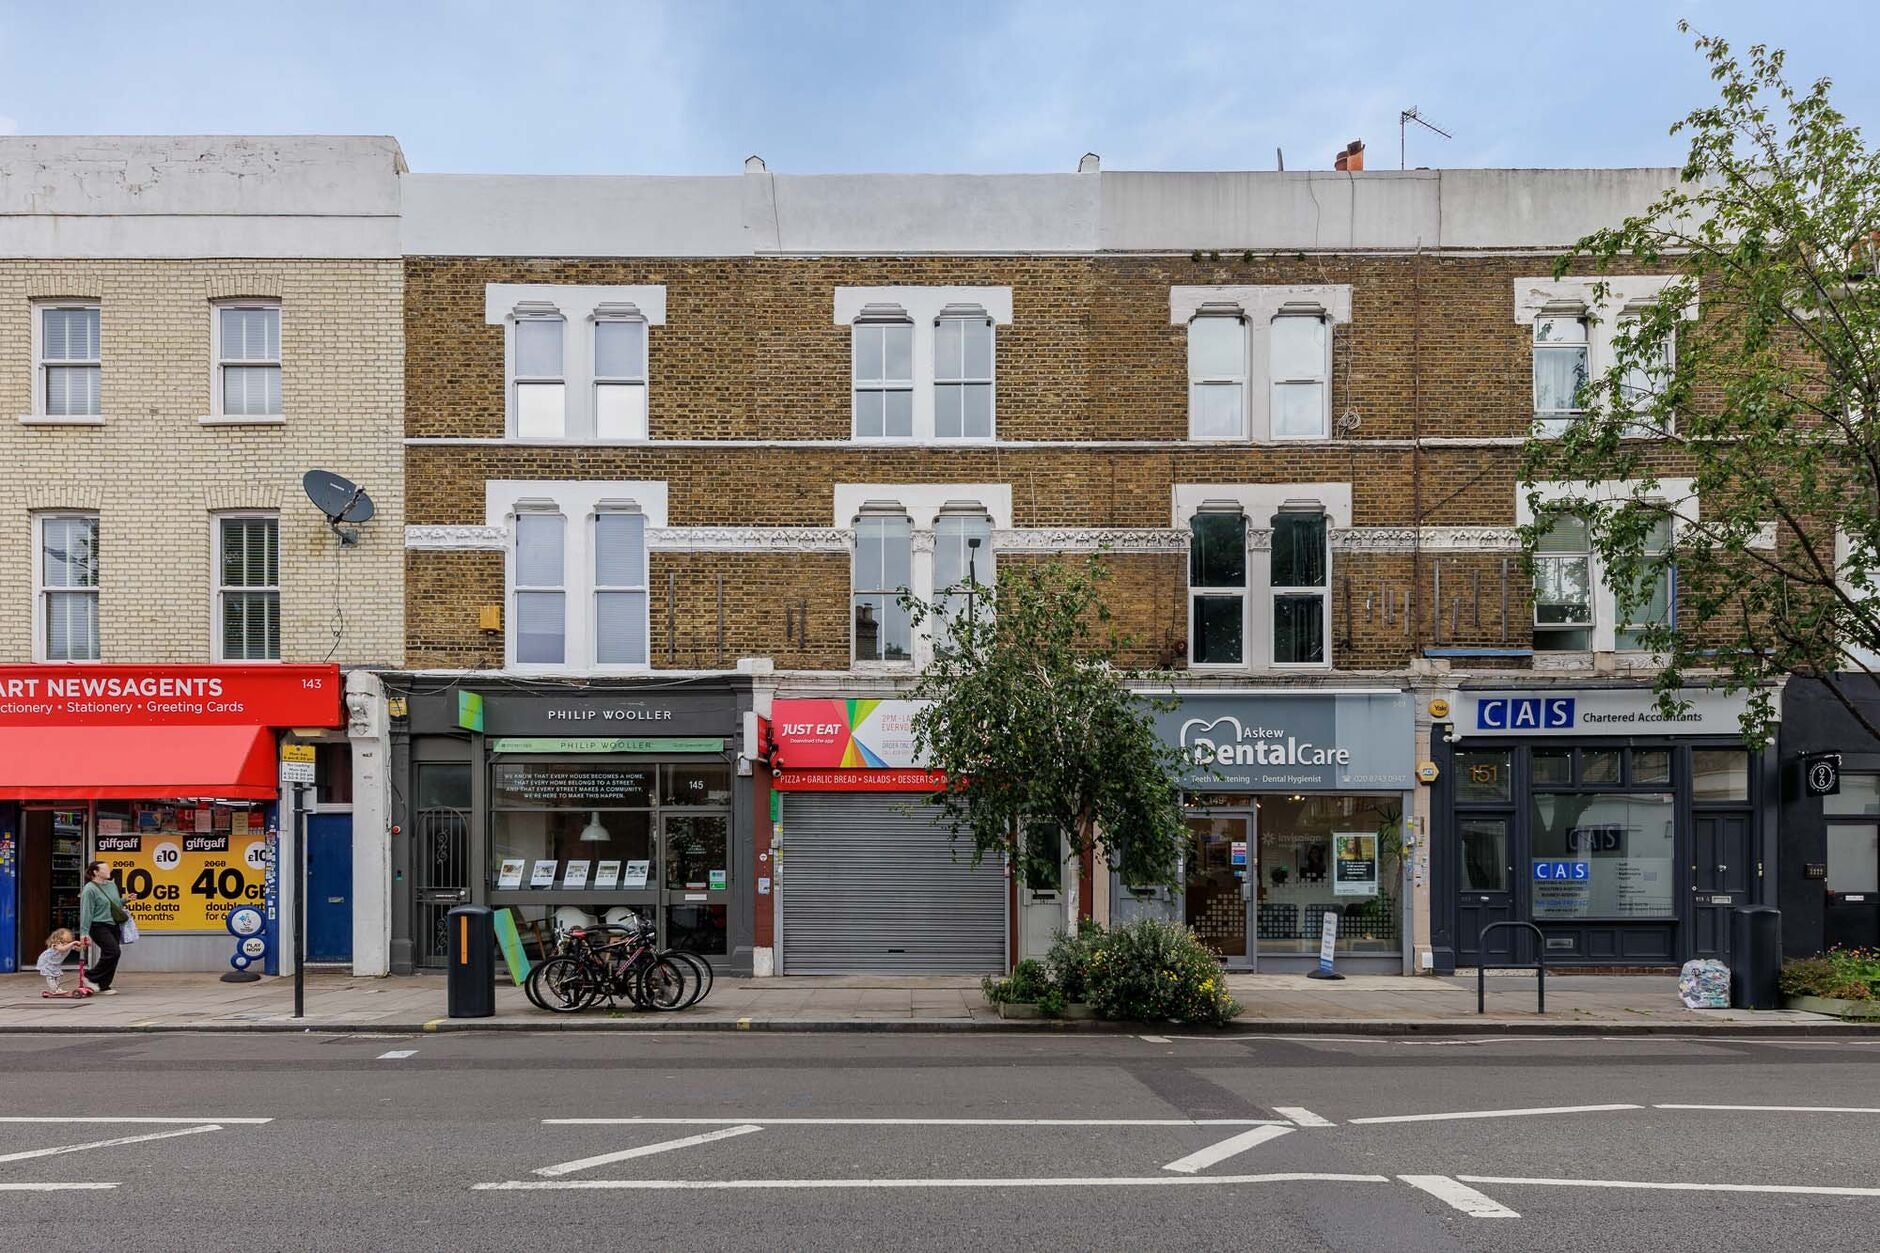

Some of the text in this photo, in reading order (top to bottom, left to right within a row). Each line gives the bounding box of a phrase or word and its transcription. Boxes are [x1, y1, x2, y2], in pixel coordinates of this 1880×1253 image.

[47, 678, 223, 697] NEWSAGENTS
[301, 679, 322, 689] 143
[67, 702, 133, 714] Stationery
[147, 701, 202, 714] Greeting
[207, 701, 244, 713] Cards
[1484, 700, 1567, 726] CAS
[548, 710, 672, 720] PHILIP WOOLLER
[1583, 712, 1635, 723] Chartered
[781, 724, 842, 737] JUST EAT
[1243, 727, 1284, 738] Askew
[602, 741, 652, 749] WOOLLER
[689, 781, 704, 789] 145
[780, 775, 800, 784] PIZZA
[807, 775, 832, 784] GARLIC
[834, 775, 857, 784] BREAD
[863, 775, 891, 784] SALADS
[898, 775, 933, 784] DESSERTS
[1192, 775, 1322, 785] Teeth Wtening Dental Hygienist
[99, 838, 226, 851] giffgaff giffgaff
[156, 850, 178, 862] £10
[1537, 864, 1584, 878] CAS
[154, 902, 180, 911] data
[206, 912, 218, 920] for
